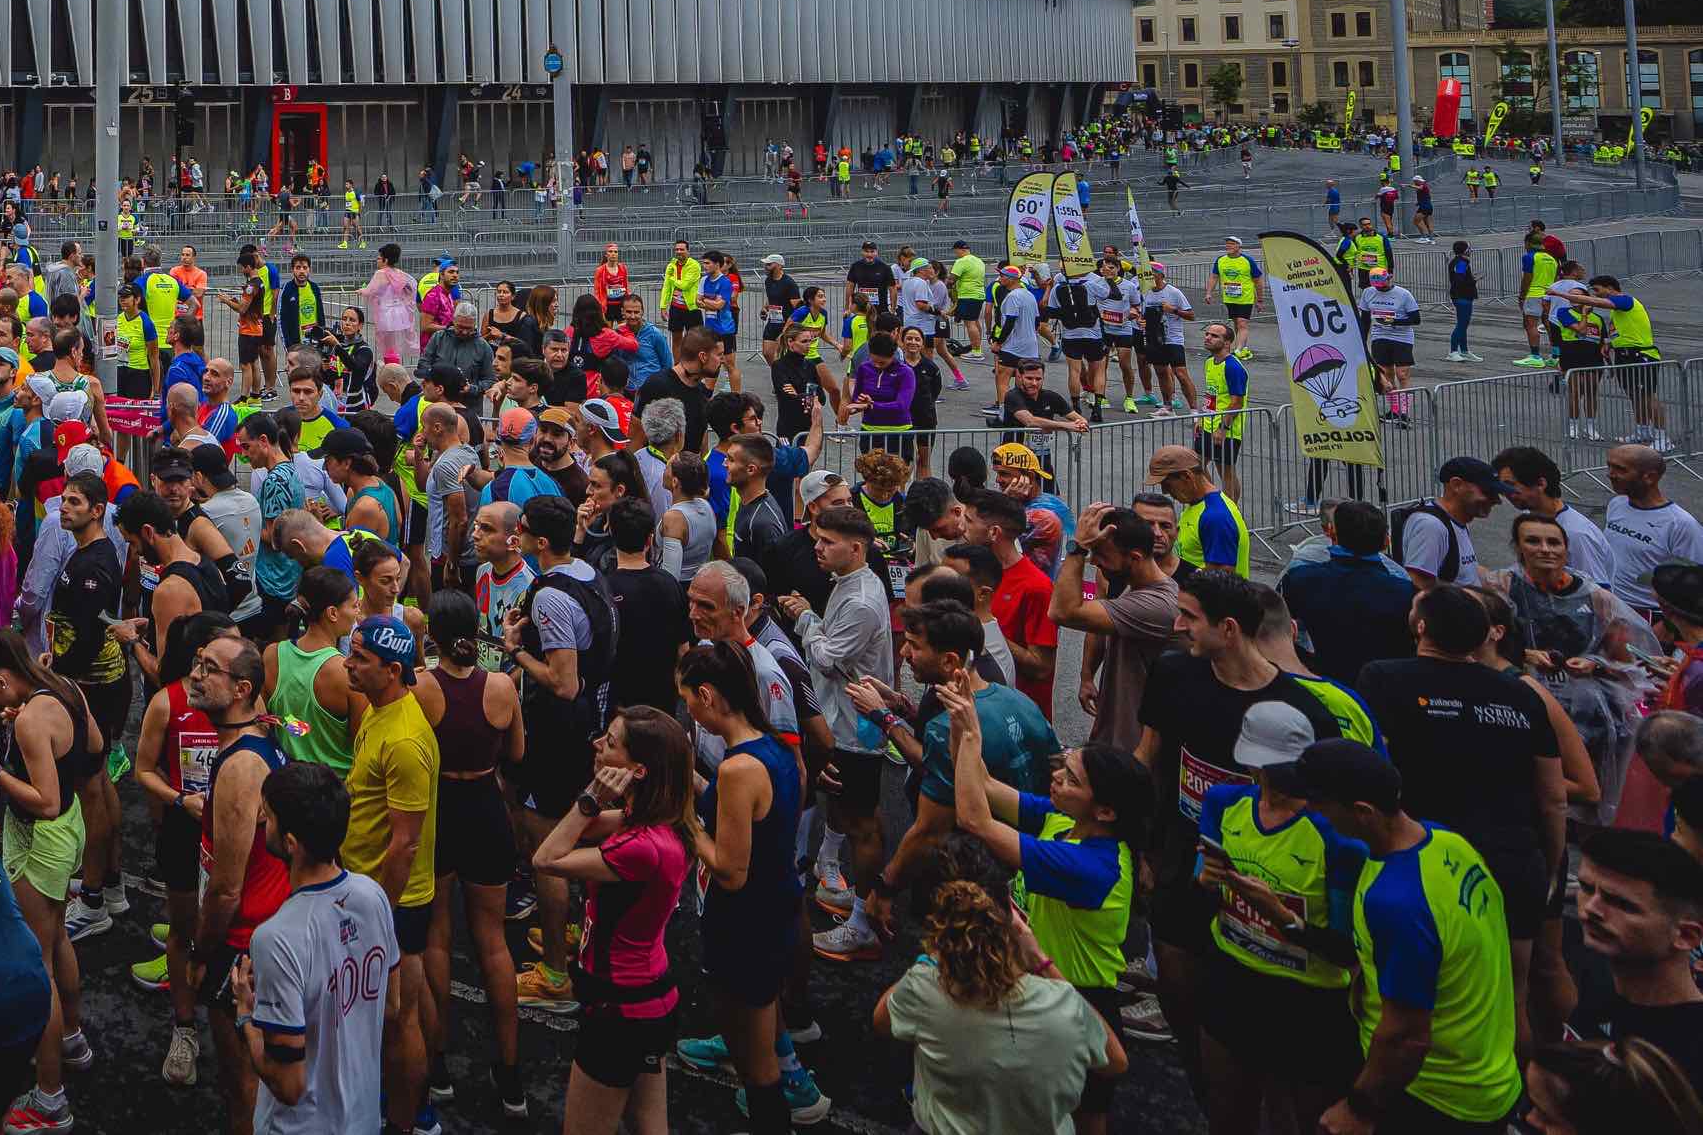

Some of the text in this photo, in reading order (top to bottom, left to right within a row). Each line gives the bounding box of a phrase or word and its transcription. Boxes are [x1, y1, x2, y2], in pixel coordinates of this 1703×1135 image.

[127, 87, 154, 104] 25
[284, 87, 291, 101] B
[502, 84, 522, 100] 24
[1016, 199, 1043, 214] 60'
